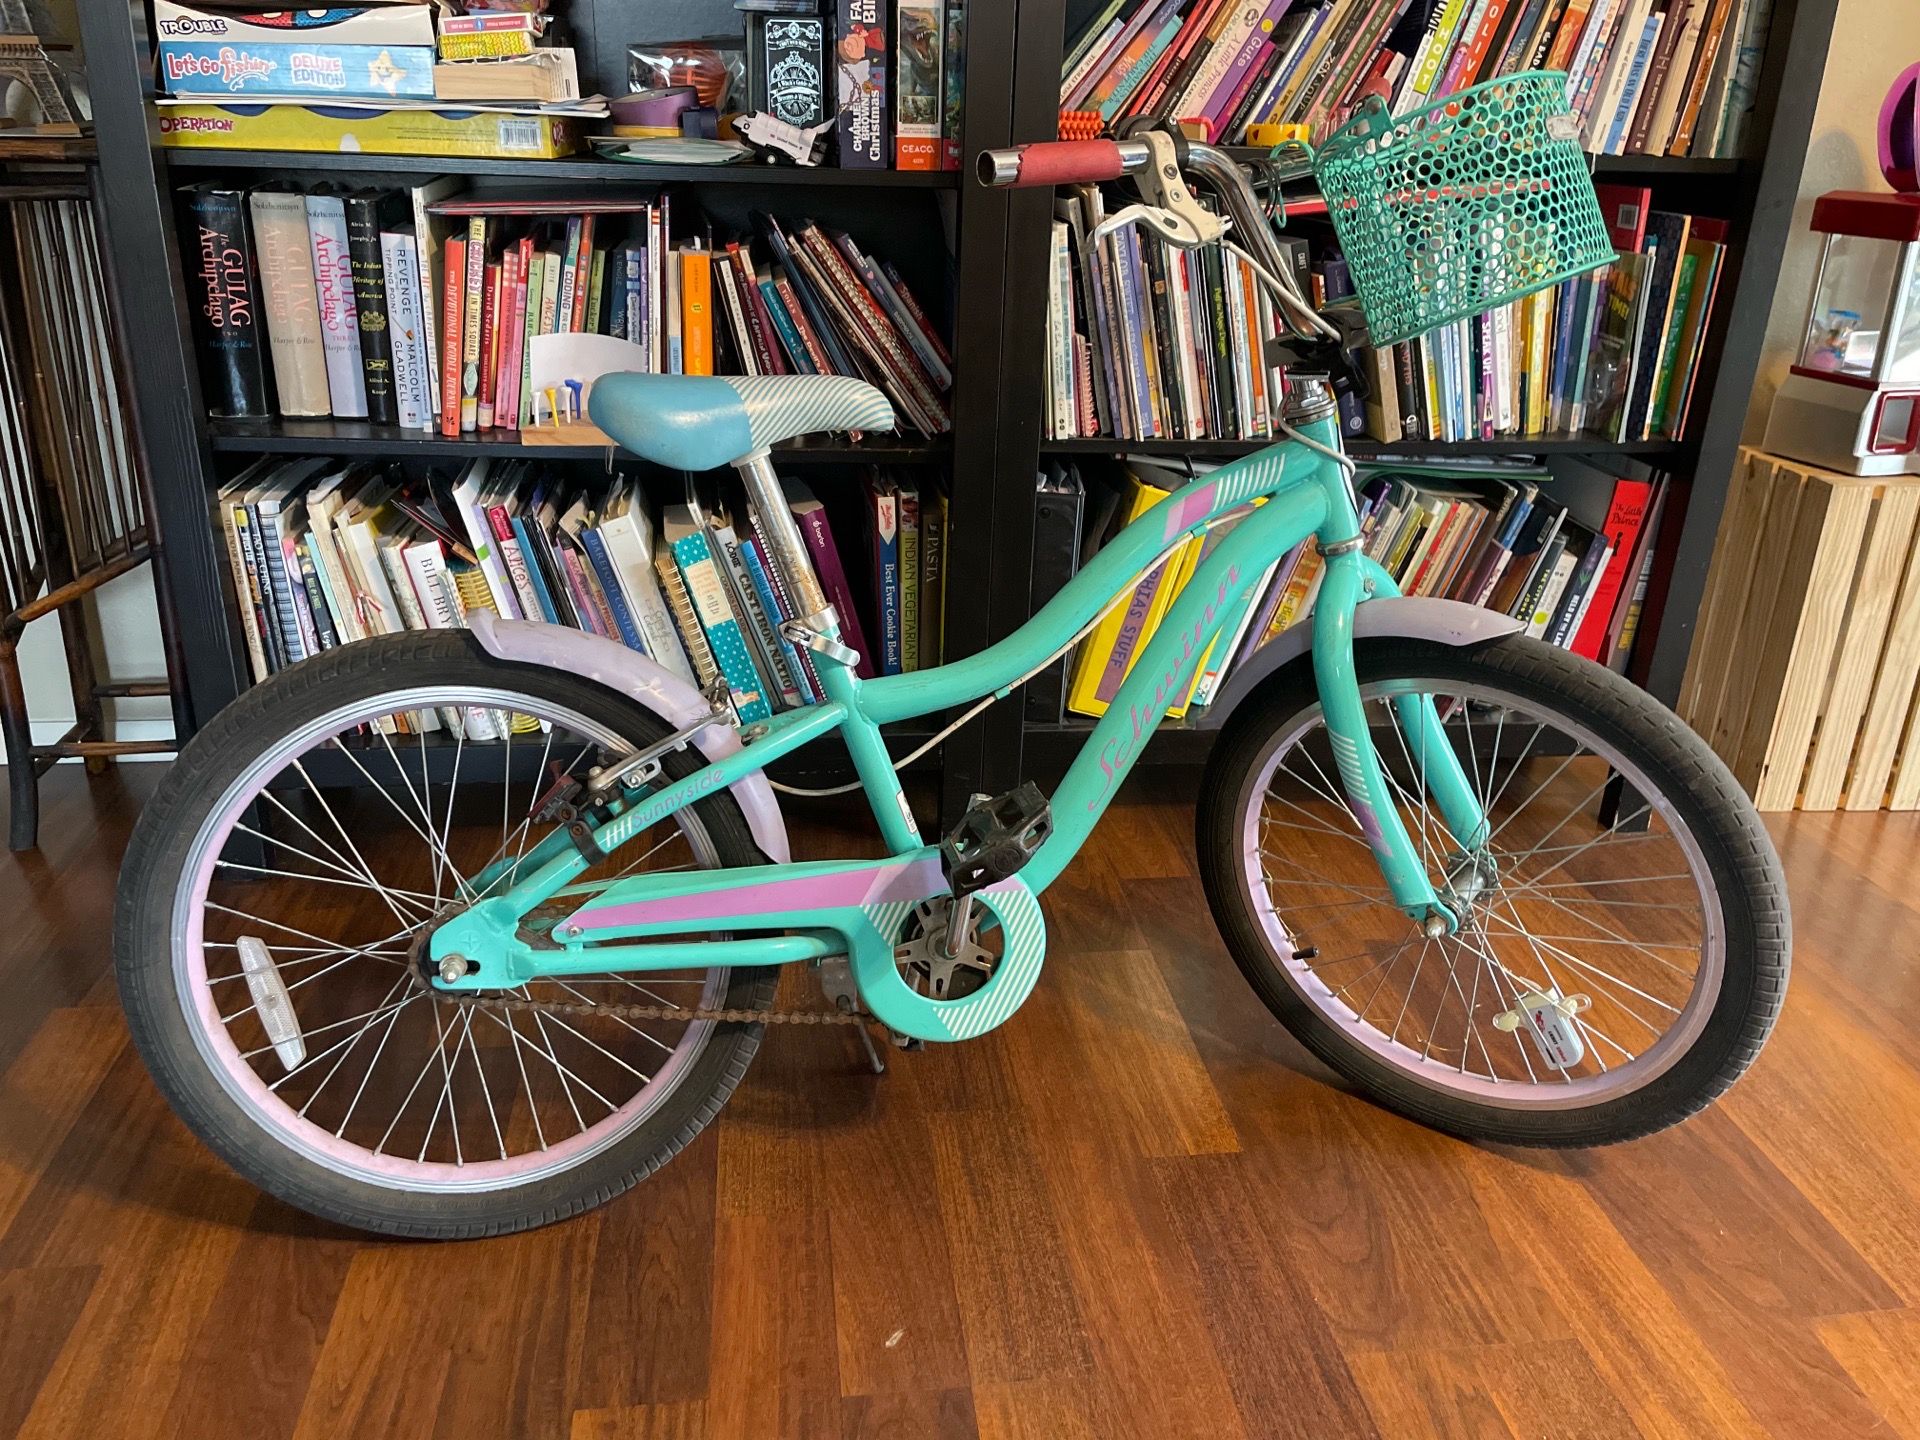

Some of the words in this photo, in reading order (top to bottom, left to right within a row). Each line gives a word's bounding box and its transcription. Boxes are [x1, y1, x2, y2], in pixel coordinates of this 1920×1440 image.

[160, 17, 228, 34] TROUBLE
[1156, 0, 1180, 26] O'Connor
[1141, 42, 1155, 58] THE
[1233, 34, 1264, 70] Guts
[1540, 30, 1552, 44] the
[167, 53, 198, 79] Let's
[200, 57, 219, 75] Go
[292, 54, 341, 71] DELUXE
[1084, 53, 1096, 67] THE
[1114, 53, 1136, 78] Wish
[1145, 51, 1157, 64] THE
[1215, 42, 1237, 67] Little
[1316, 51, 1337, 78] ZEN
[1420, 27, 1451, 85] HOOT
[1530, 44, 1546, 67] BAD
[293, 68, 344, 86] EDITION
[1070, 66, 1086, 85] JOLLY
[1106, 56, 1144, 105] CARPENTER
[1118, 61, 1149, 100] WALRUS
[1193, 64, 1224, 100] Princess
[862, 96, 871, 141] BROWN
[1172, 96, 1189, 116] SAGAN
[160, 117, 234, 133] OPERATION
[849, 102, 863, 152] CHARLIE
[870, 90, 881, 161] Christmas
[473, 224, 482, 236] THE
[199, 225, 225, 328] Archipelago
[352, 261, 361, 269] The
[353, 277, 376, 285] Heritage
[384, 248, 394, 284] TIPPING
[1115, 232, 1127, 276] TAYLOR
[1123, 279, 1133, 315] SWIFT
[222, 249, 251, 328] GULAG
[286, 246, 314, 322] GULAG
[315, 233, 340, 331] Archipelago
[336, 255, 357, 331] GULAG
[396, 248, 411, 315] REVENGE
[561, 270, 573, 310] CODING
[388, 286, 397, 314] POINT
[446, 283, 457, 338] DEVOTIONAL
[469, 297, 478, 305] IN
[485, 286, 494, 311] David
[727, 282, 737, 304] GLASS
[734, 307, 744, 333] CASTLE
[781, 288, 797, 315] YOLEN
[898, 285, 925, 322] Spanish
[469, 308, 478, 328] TIMES
[483, 313, 492, 345] Sedaris
[750, 317, 767, 351] CAPTAIN
[467, 330, 477, 357] SQUARE
[798, 325, 809, 341] The
[805, 340, 822, 368] Devil's
[1482, 321, 1492, 354] SPEAK
[445, 340, 457, 372] DOODLE
[1482, 356, 1493, 376] UP!
[393, 339, 409, 406] GLADWELL
[405, 342, 420, 403] MALCOLM
[445, 373, 456, 409] JOURNAL
[224, 518, 233, 534] THE
[1611, 511, 1639, 527] Prince
[1624, 504, 1642, 517] Little
[251, 531, 263, 552] TAO
[255, 553, 266, 568] TE
[502, 542, 534, 591] Alice's
[884, 563, 895, 583] Best
[904, 537, 916, 580] INDIAN
[926, 537, 939, 583] PASTA
[258, 567, 271, 596] CHING
[419, 556, 442, 592] BILL
[432, 595, 453, 626] BRY
[585, 537, 621, 594] BAREFOOT
[610, 594, 646, 650] CONTESSA
[886, 585, 895, 606] Ever
[719, 574, 737, 604] COOKIES
[731, 603, 742, 618] FOR
[737, 617, 748, 634] KIDS
[724, 539, 742, 568] LODGE
[737, 572, 759, 608] CAST
[752, 609, 775, 646] IRON
[768, 646, 793, 689] NATIO
[246, 625, 255, 644] WING
[886, 608, 897, 639] Cookie
[904, 584, 916, 660] VEGETARIAN
[887, 641, 897, 665] Book!
[1110, 625, 1136, 668] STUFF
[1088, 563, 1242, 812] Schwinn
[632, 767, 726, 829] Sunnyside
